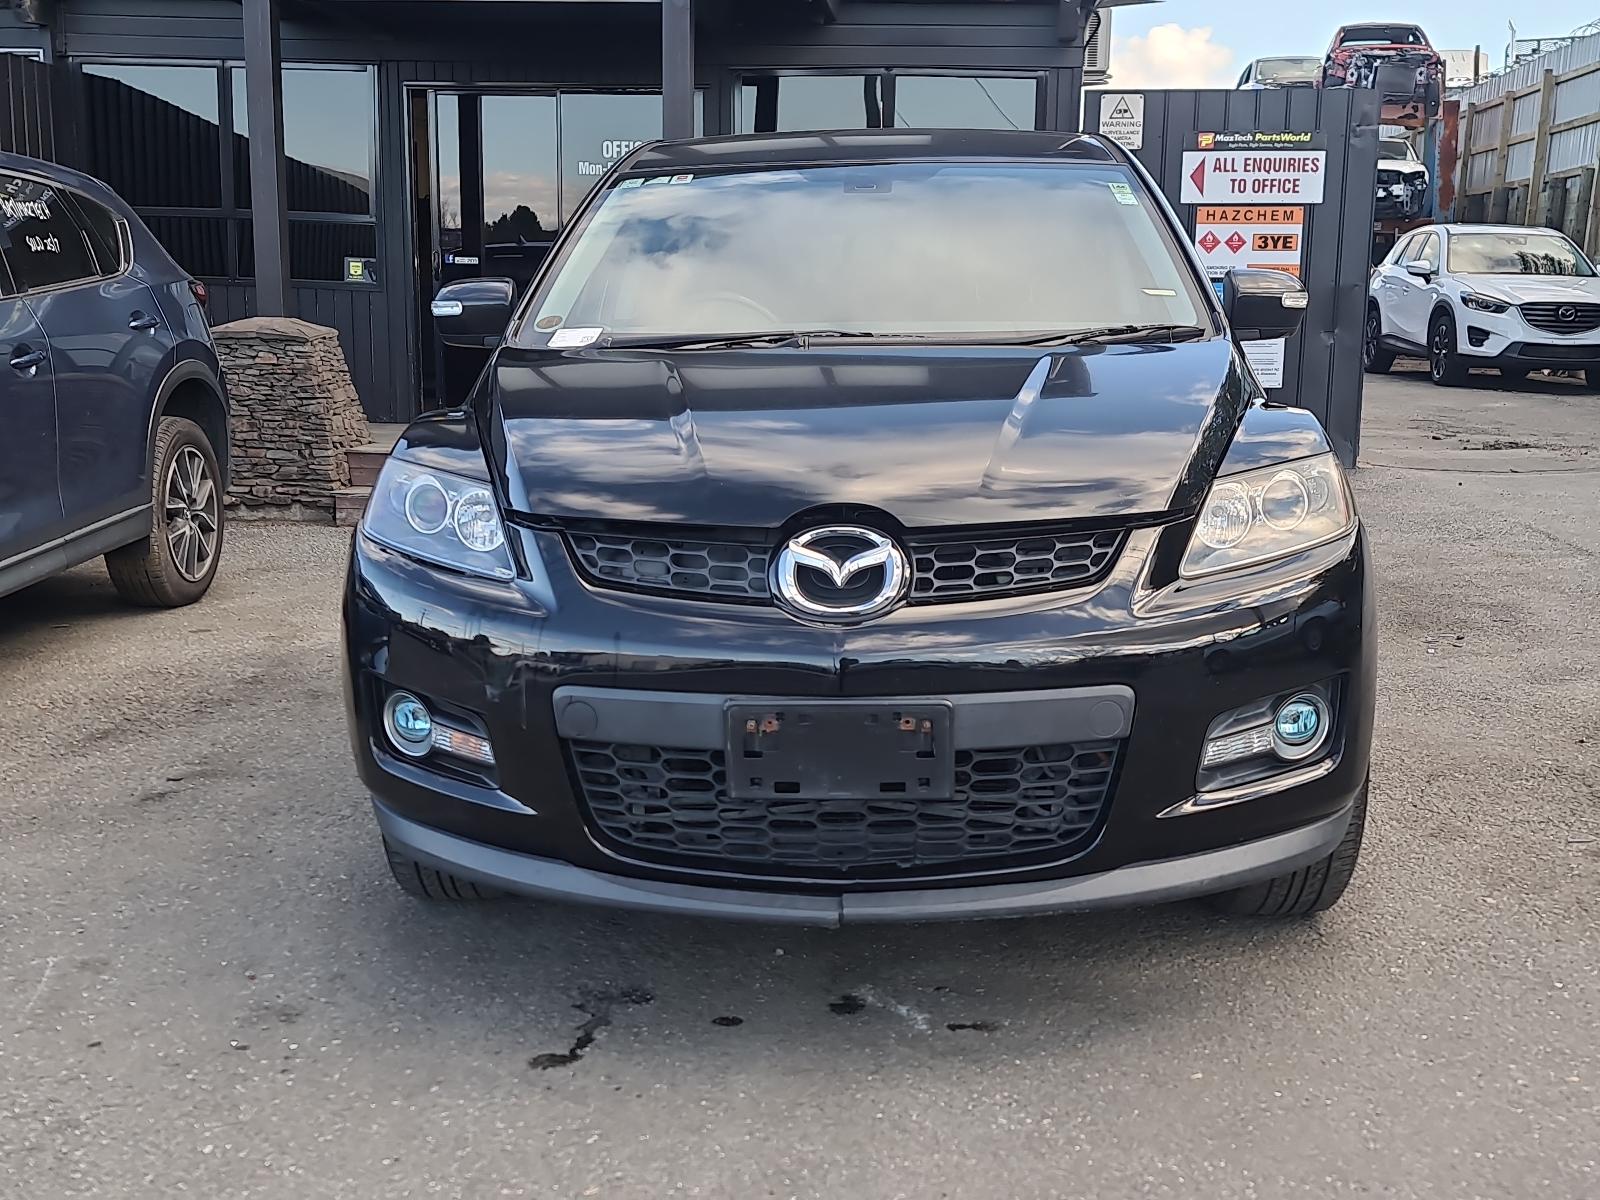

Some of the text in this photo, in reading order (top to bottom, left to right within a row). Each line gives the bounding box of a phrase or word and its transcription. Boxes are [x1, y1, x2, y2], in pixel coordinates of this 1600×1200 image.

[1101, 120, 1142, 128] WARNING
[1214, 132, 1312, 142] MazTech PartsWorld
[1212, 157, 1320, 174] ALL ENQUIRIES
[1229, 178, 1300, 193] TO OFFICE
[1206, 209, 1294, 221] HAZCHEM
[1257, 235, 1293, 250] 3YE
